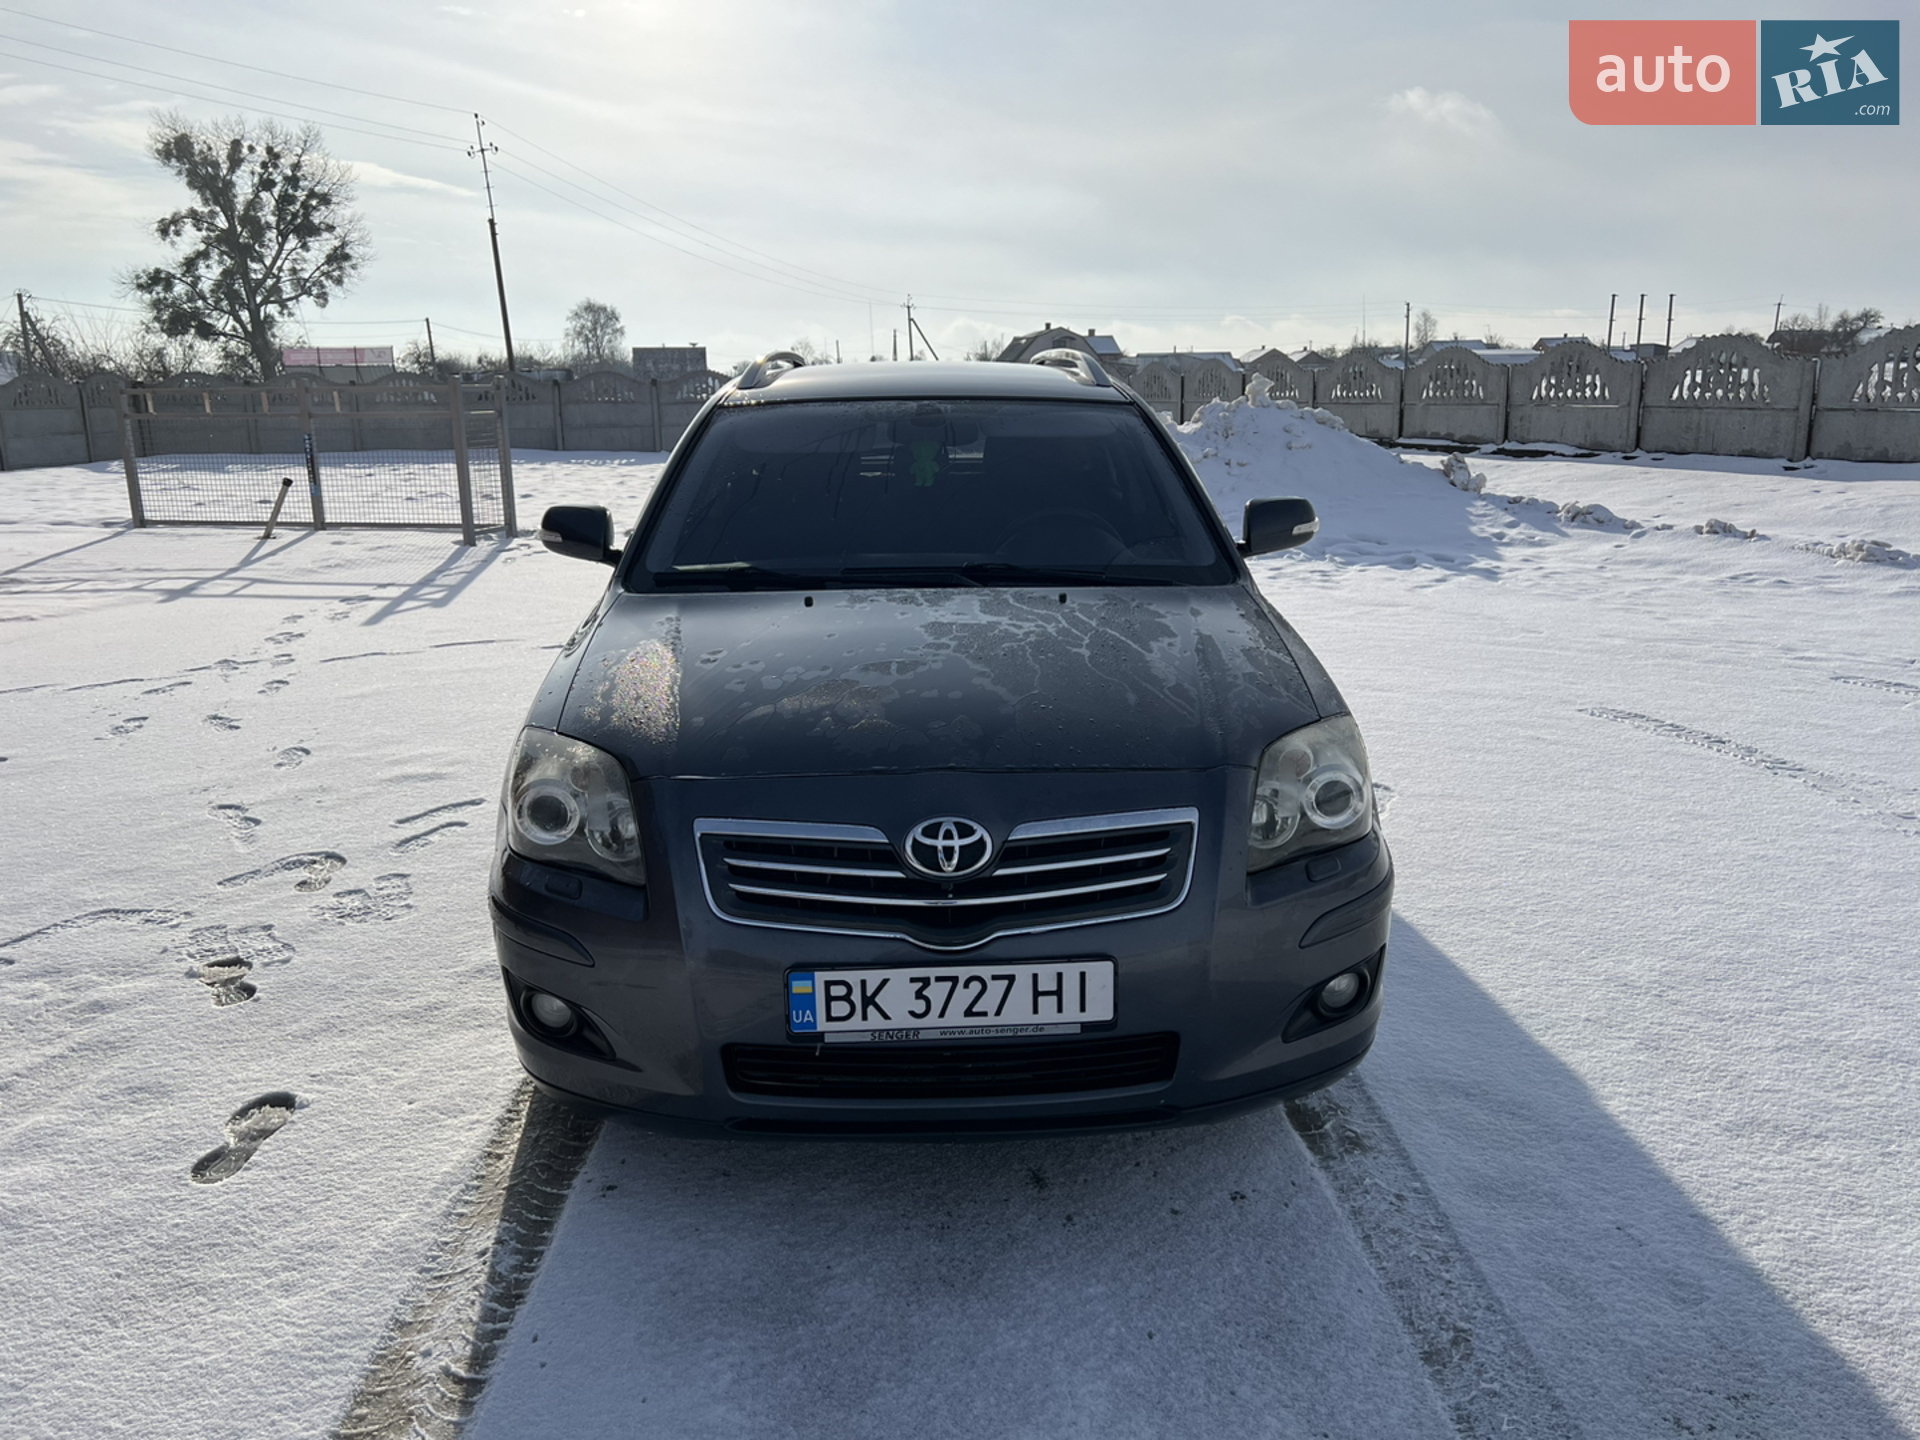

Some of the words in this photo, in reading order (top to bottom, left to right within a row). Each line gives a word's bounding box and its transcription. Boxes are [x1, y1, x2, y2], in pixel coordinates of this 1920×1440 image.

[824, 978, 892, 1022] BK
[908, 975, 1016, 1019] 3727
[1031, 971, 1087, 1015] HI
[793, 1010, 814, 1024] UA
[870, 1031, 921, 1042] SENGER
[939, 1025, 1045, 1036] www.auto-senger.de
